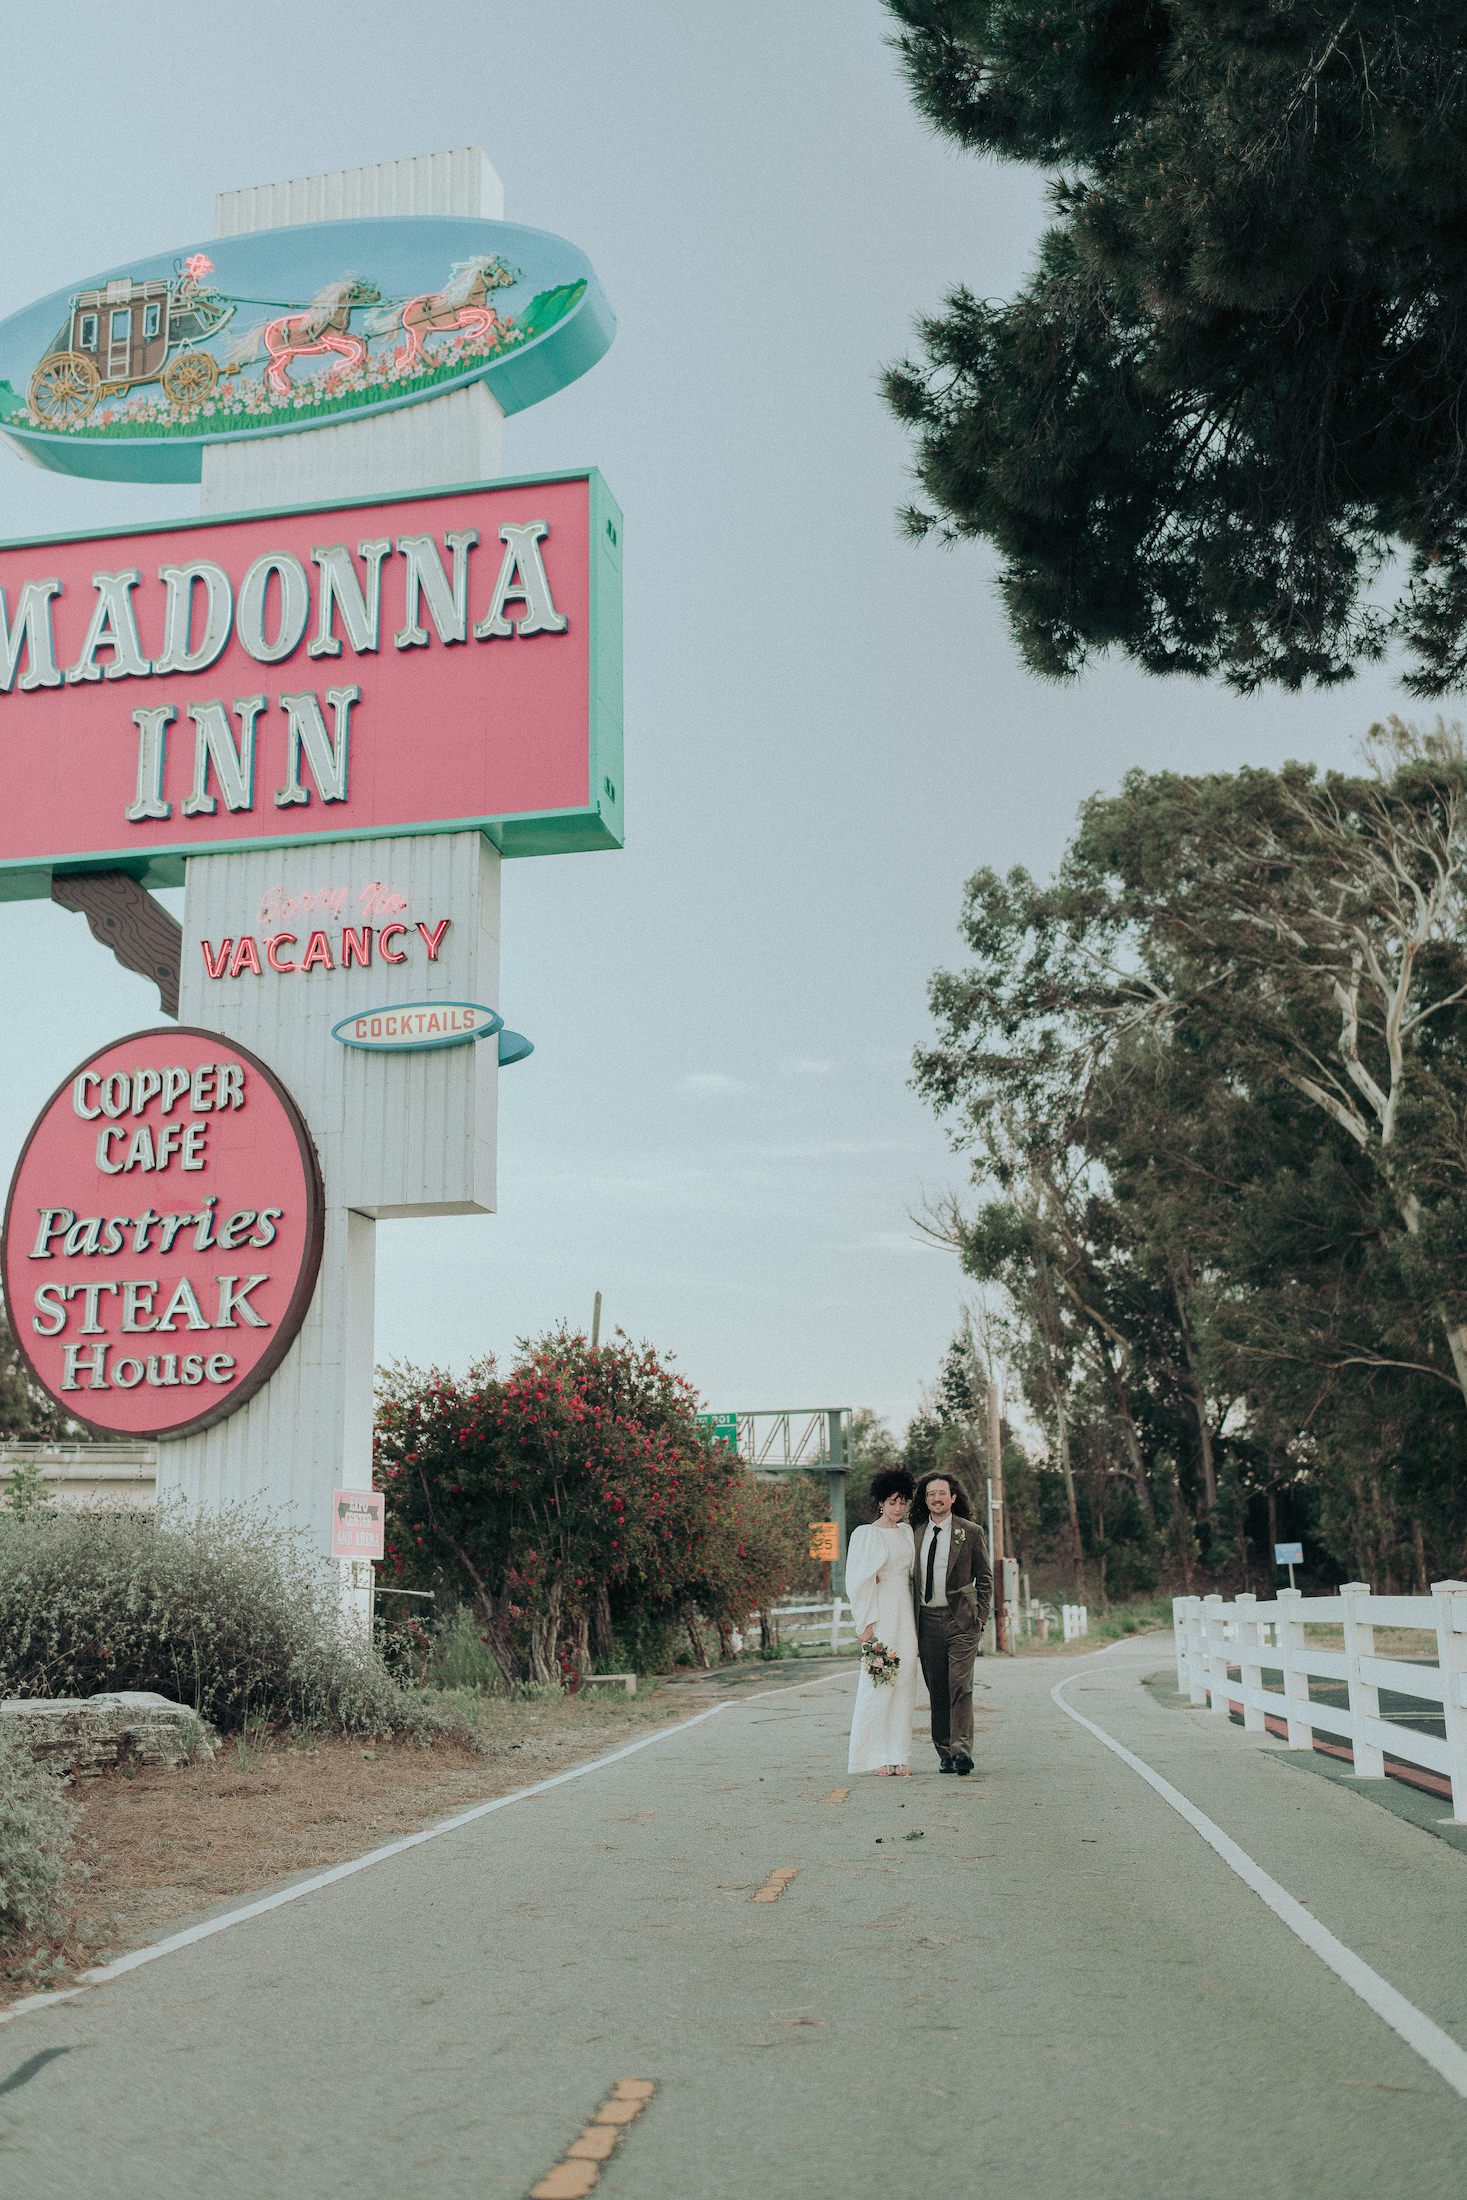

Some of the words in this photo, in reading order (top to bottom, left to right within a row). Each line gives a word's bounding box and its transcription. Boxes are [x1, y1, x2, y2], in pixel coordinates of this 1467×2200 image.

[0, 520, 568, 694] MADONNA
[125, 684, 361, 822] INN
[256, 887, 350, 924] Sorry
[358, 881, 409, 917] No
[201, 919, 453, 979] VACANCY
[355, 1009, 475, 1039] COCKTAILS
[72, 1062, 245, 1121] COPPER
[95, 1121, 208, 1175] CAFE
[27, 1195, 284, 1259] Pastries
[32, 1274, 271, 1338] STEAK
[60, 1343, 236, 1392] House
